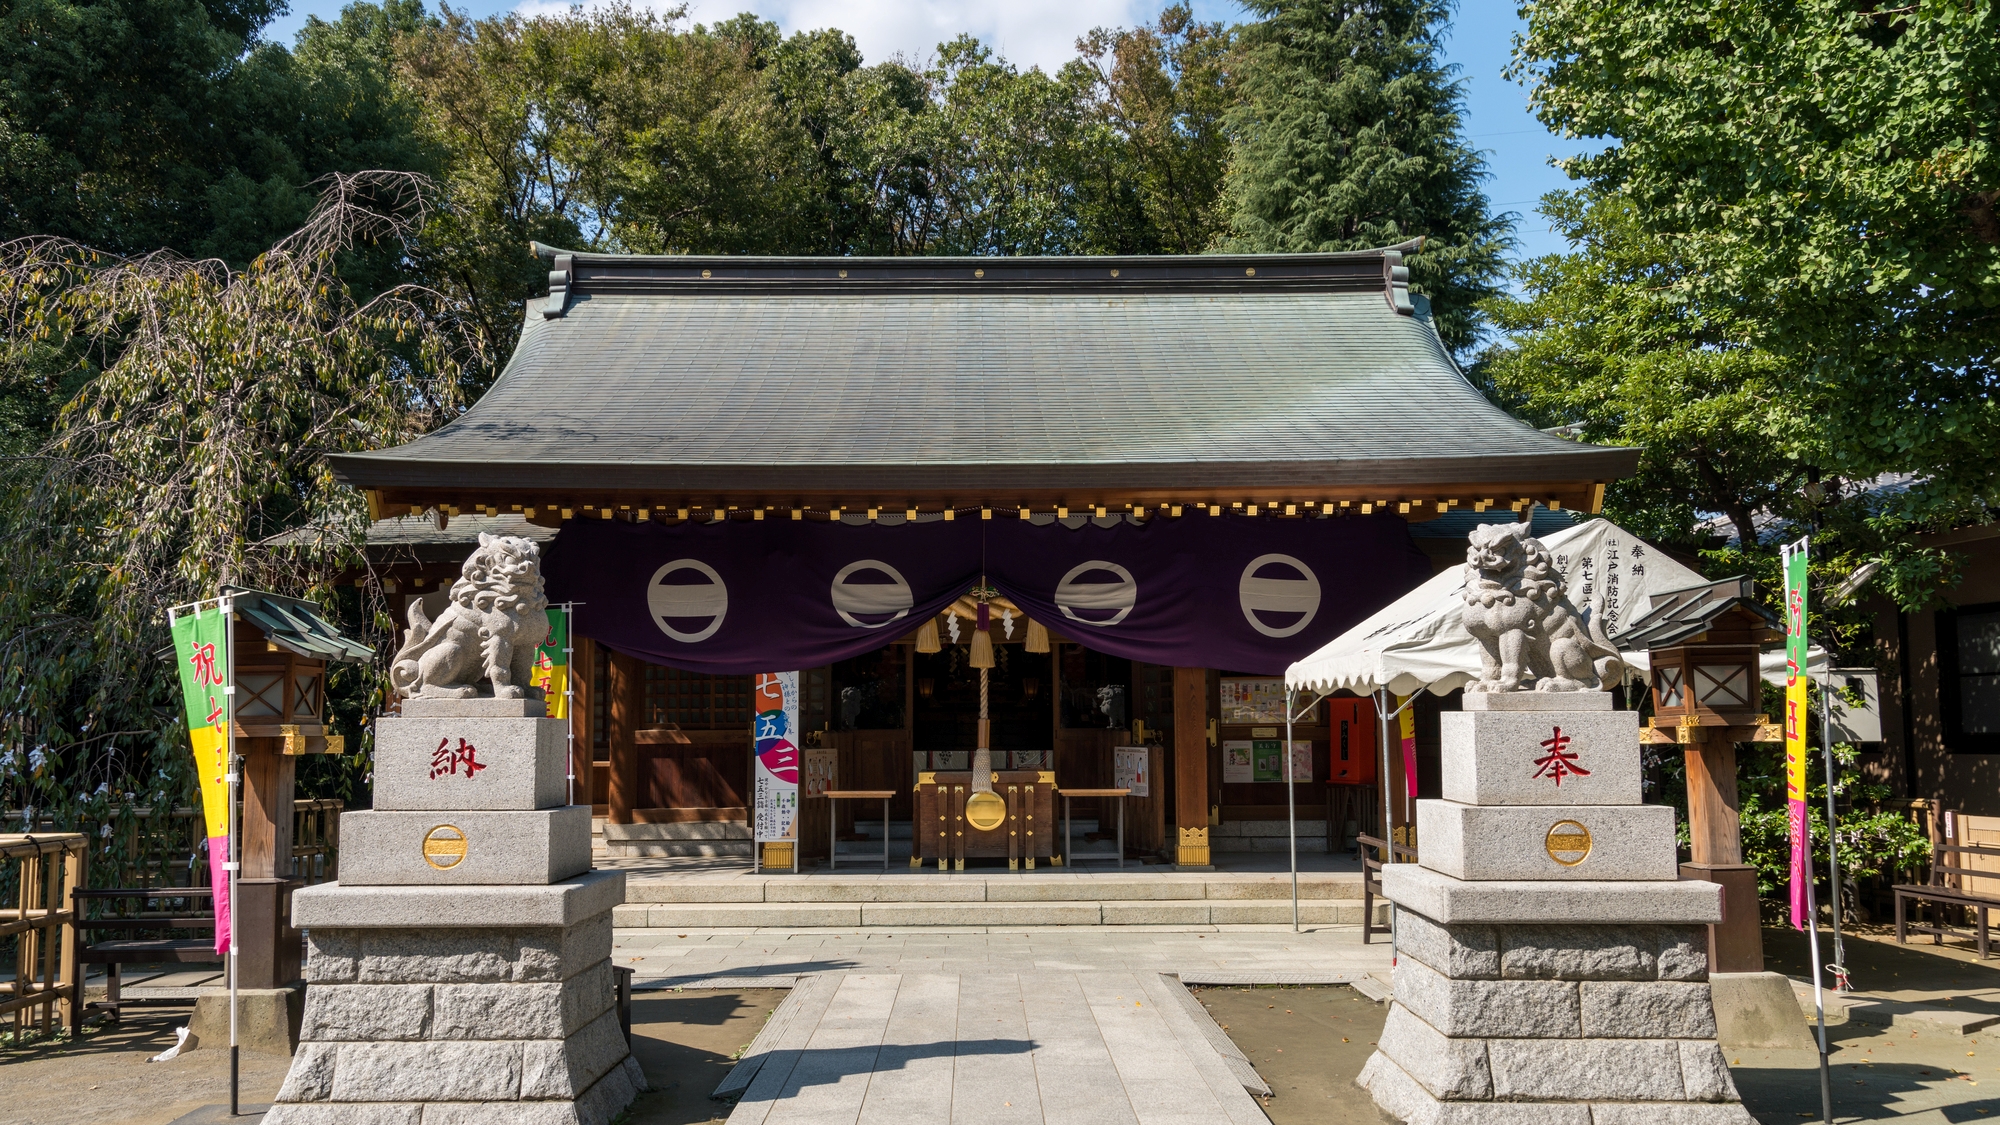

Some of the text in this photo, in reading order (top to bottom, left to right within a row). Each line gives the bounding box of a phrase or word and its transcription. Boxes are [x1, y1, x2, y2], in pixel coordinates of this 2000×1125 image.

[1630, 544, 1645, 576] 奉納
[756, 673, 799, 773] 七五三
[429, 737, 487, 780] 納
[1532, 726, 1591, 787] 奉
